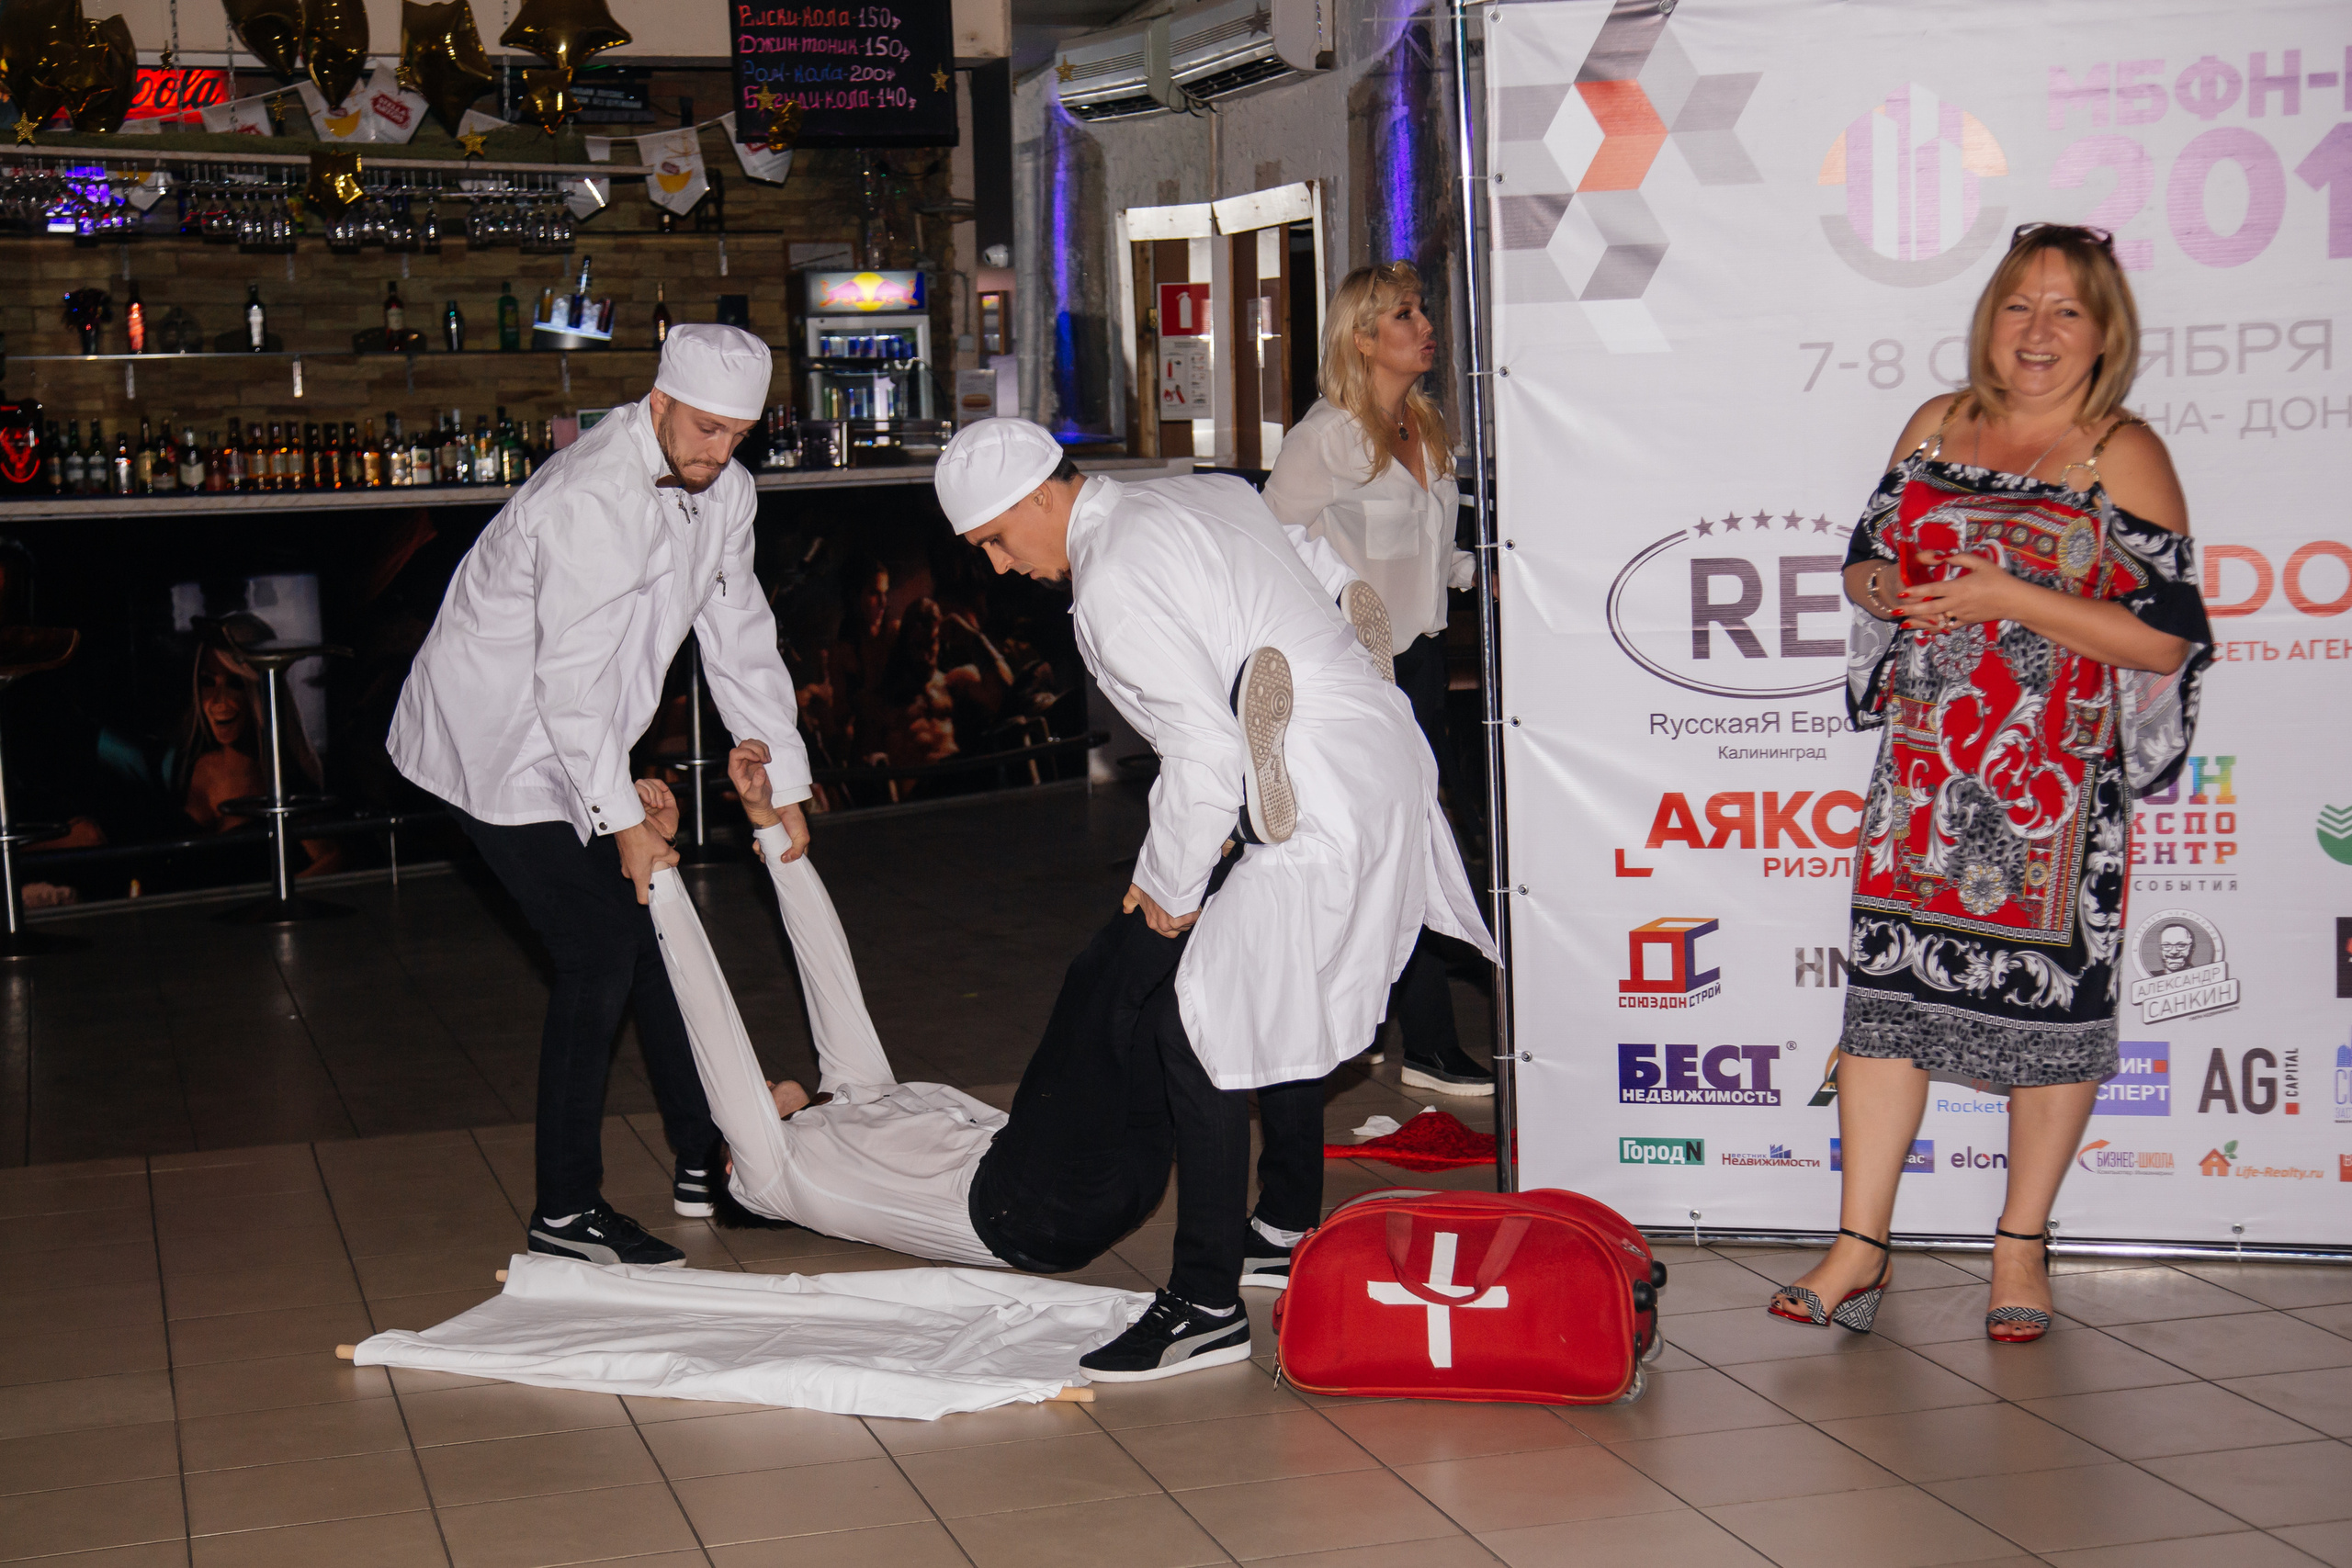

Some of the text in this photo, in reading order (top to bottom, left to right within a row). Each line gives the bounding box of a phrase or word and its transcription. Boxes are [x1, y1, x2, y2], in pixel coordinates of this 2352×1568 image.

[2047, 45, 2352, 130] МБФН-
[1798, 337, 1906, 393] 7-8
[1718, 746, 1826, 762] Калининград
[1644, 789, 1866, 850] АЯКС
[2132, 811, 2236, 835] КСПО
[2130, 841, 2238, 865] ЕНТР
[1763, 856, 1857, 878] РИЭЛ
[2133, 879, 2238, 892] СОБЫТИЯ
[2137, 967, 2222, 998] АЛЕКСАНДР
[1619, 997, 1687, 1010] СОЮЗДОН
[2148, 983, 2232, 1019] САНКИН
[1618, 1043, 1781, 1089] БЕСТ
[2285, 1048, 2299, 1098] CAPITAL
[2095, 1084, 2169, 1101] СПЕРТ
[2198, 1047, 2278, 1115] AG
[1623, 1089, 1778, 1103] НЕДВИЖИМОСТЬ
[1937, 1100, 2010, 1113] Rocket
[2097, 1151, 2175, 1168] БИЗНЕС-ШКОЛА
